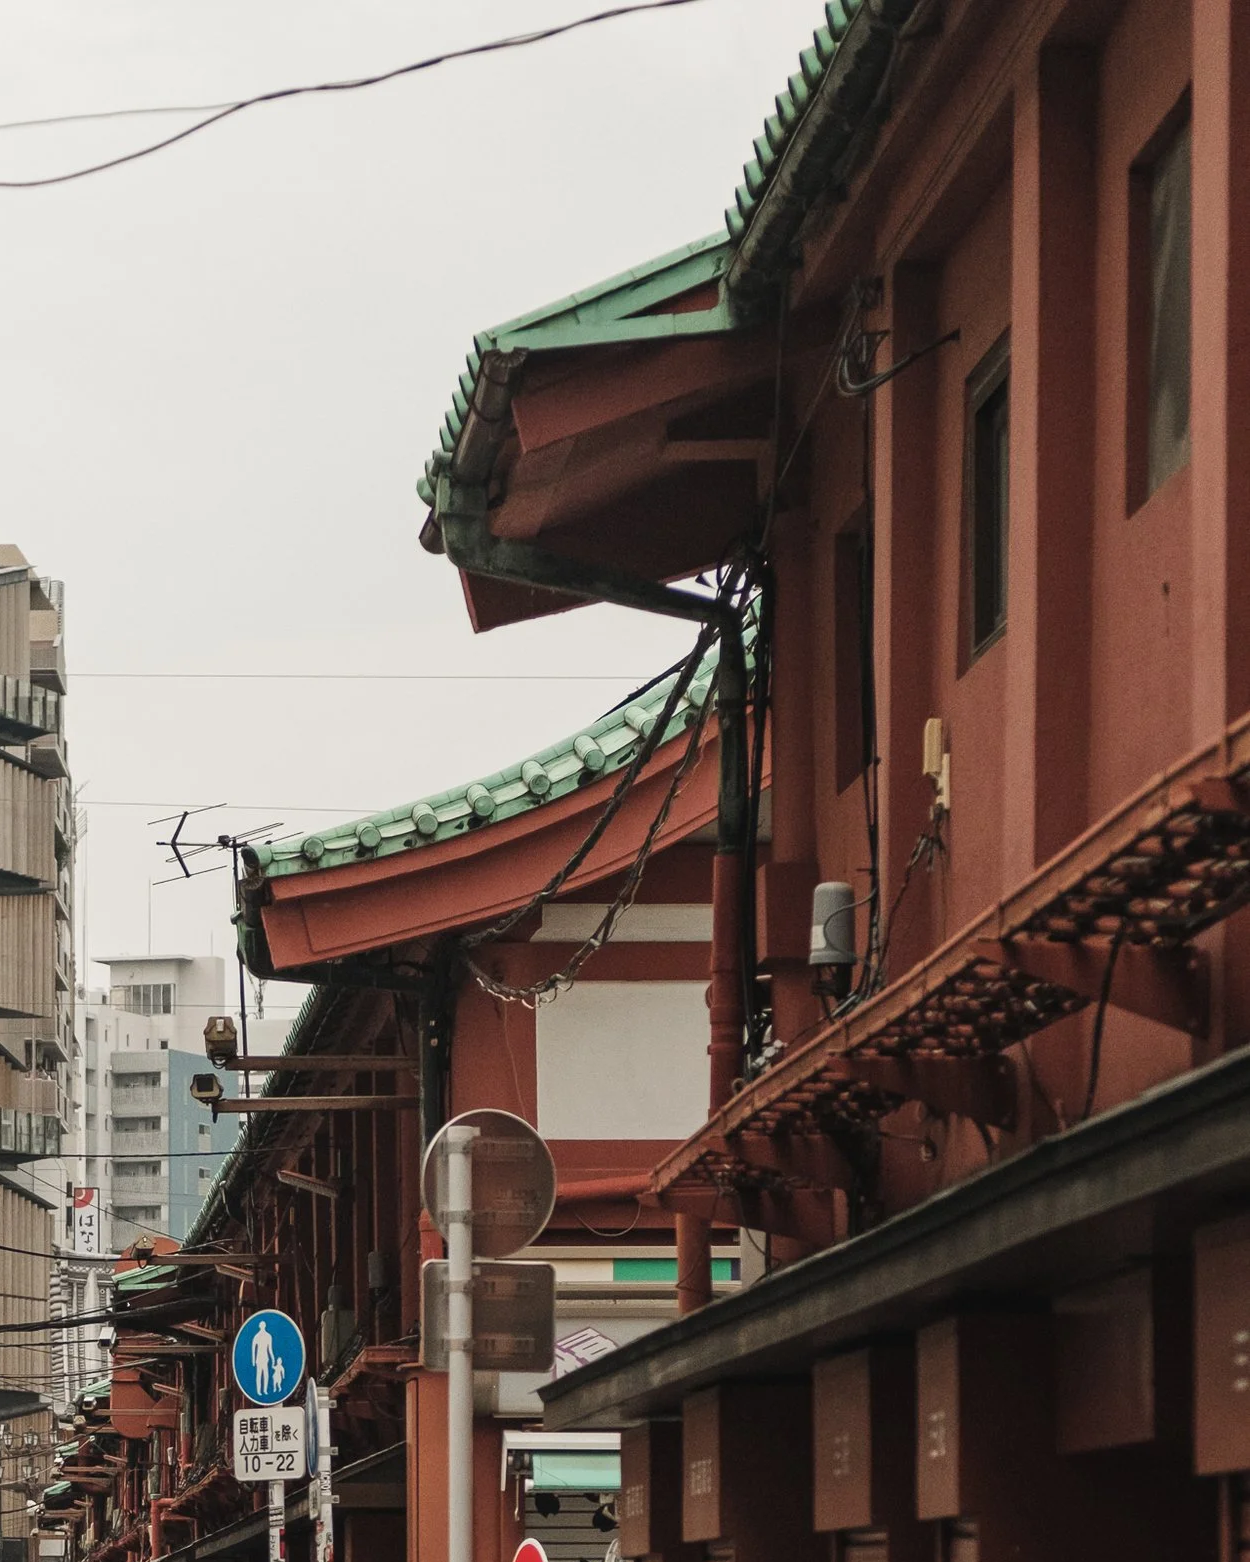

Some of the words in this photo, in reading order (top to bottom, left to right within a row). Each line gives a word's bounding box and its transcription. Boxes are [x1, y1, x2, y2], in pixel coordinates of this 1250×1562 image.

[239, 1416, 269, 1435] 自転車
[274, 1424, 299, 1442] を除く
[239, 1435, 269, 1453] 人力車
